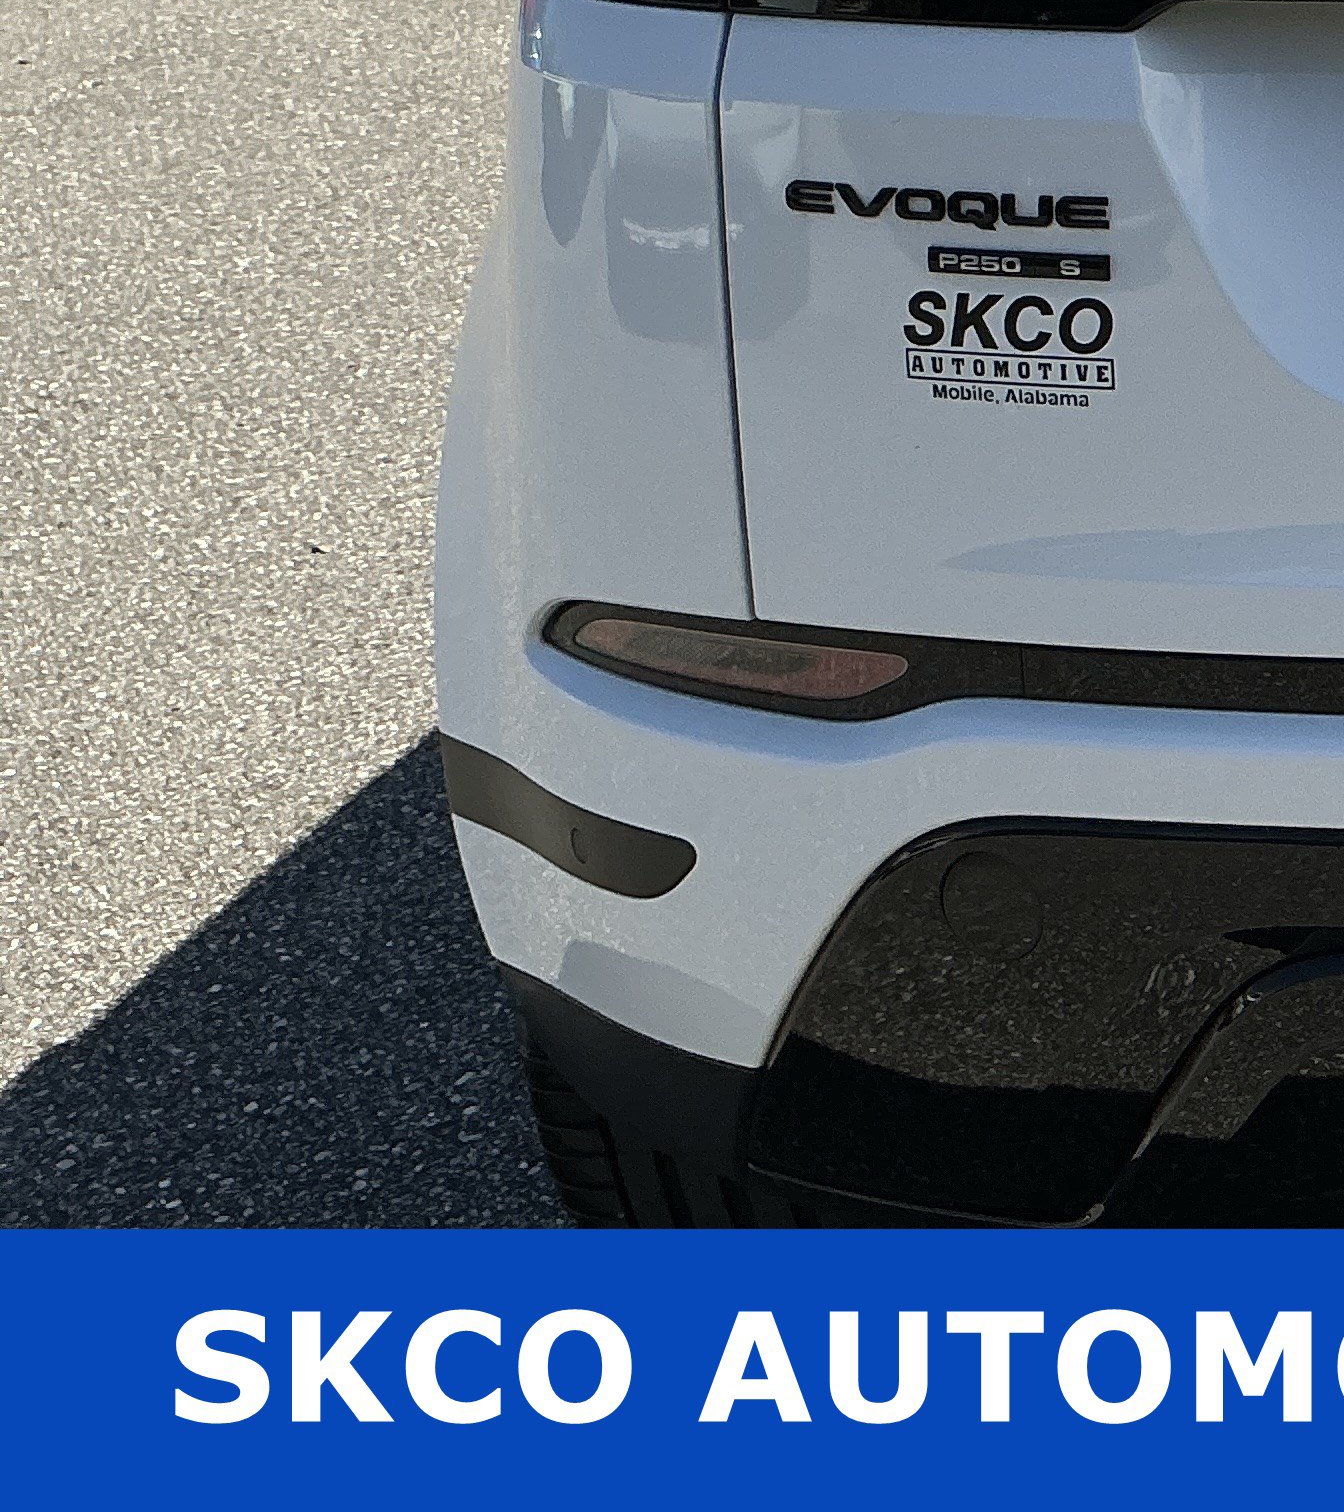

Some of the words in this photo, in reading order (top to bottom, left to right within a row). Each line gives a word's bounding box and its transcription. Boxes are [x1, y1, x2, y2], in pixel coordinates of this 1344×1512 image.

[784, 179, 1110, 231] EVOQUE
[938, 252, 1022, 274] P250
[1058, 259, 1082, 276] S
[903, 290, 1114, 355] SKCO
[911, 355, 1110, 384] AUTOMOTIVE
[932, 384, 1000, 405] Mobile,
[1004, 387, 1090, 408] Alabama
